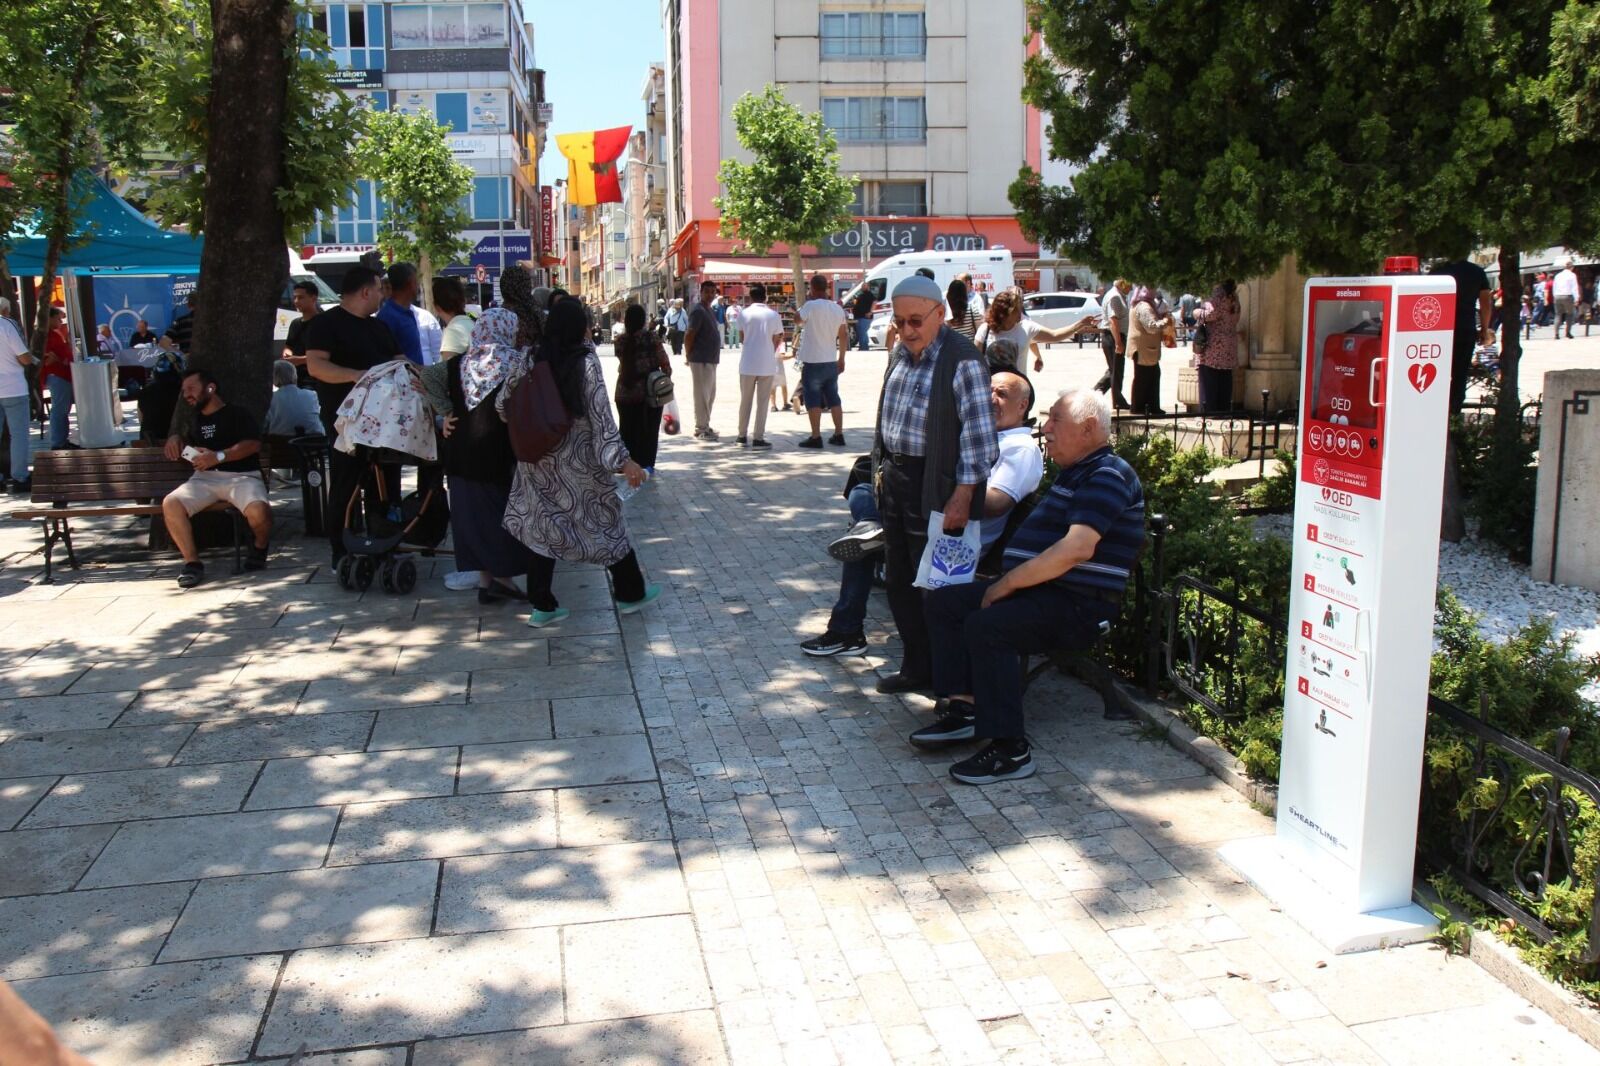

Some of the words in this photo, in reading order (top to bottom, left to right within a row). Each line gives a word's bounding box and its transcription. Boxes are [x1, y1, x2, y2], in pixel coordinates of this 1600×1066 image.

[478, 245, 501, 253] GÖRSE
[504, 245, 527, 254] LETİŞİM
[1336, 288, 1361, 297] aselsan
[1406, 344, 1442, 359] OED
[1331, 397, 1351, 411] OED
[1332, 491, 1353, 507] OED
[1307, 578, 1312, 589] 2
[1304, 625, 1310, 636] 3
[1301, 682, 1306, 692] 4
[1293, 810, 1338, 846] HEARTLINE
